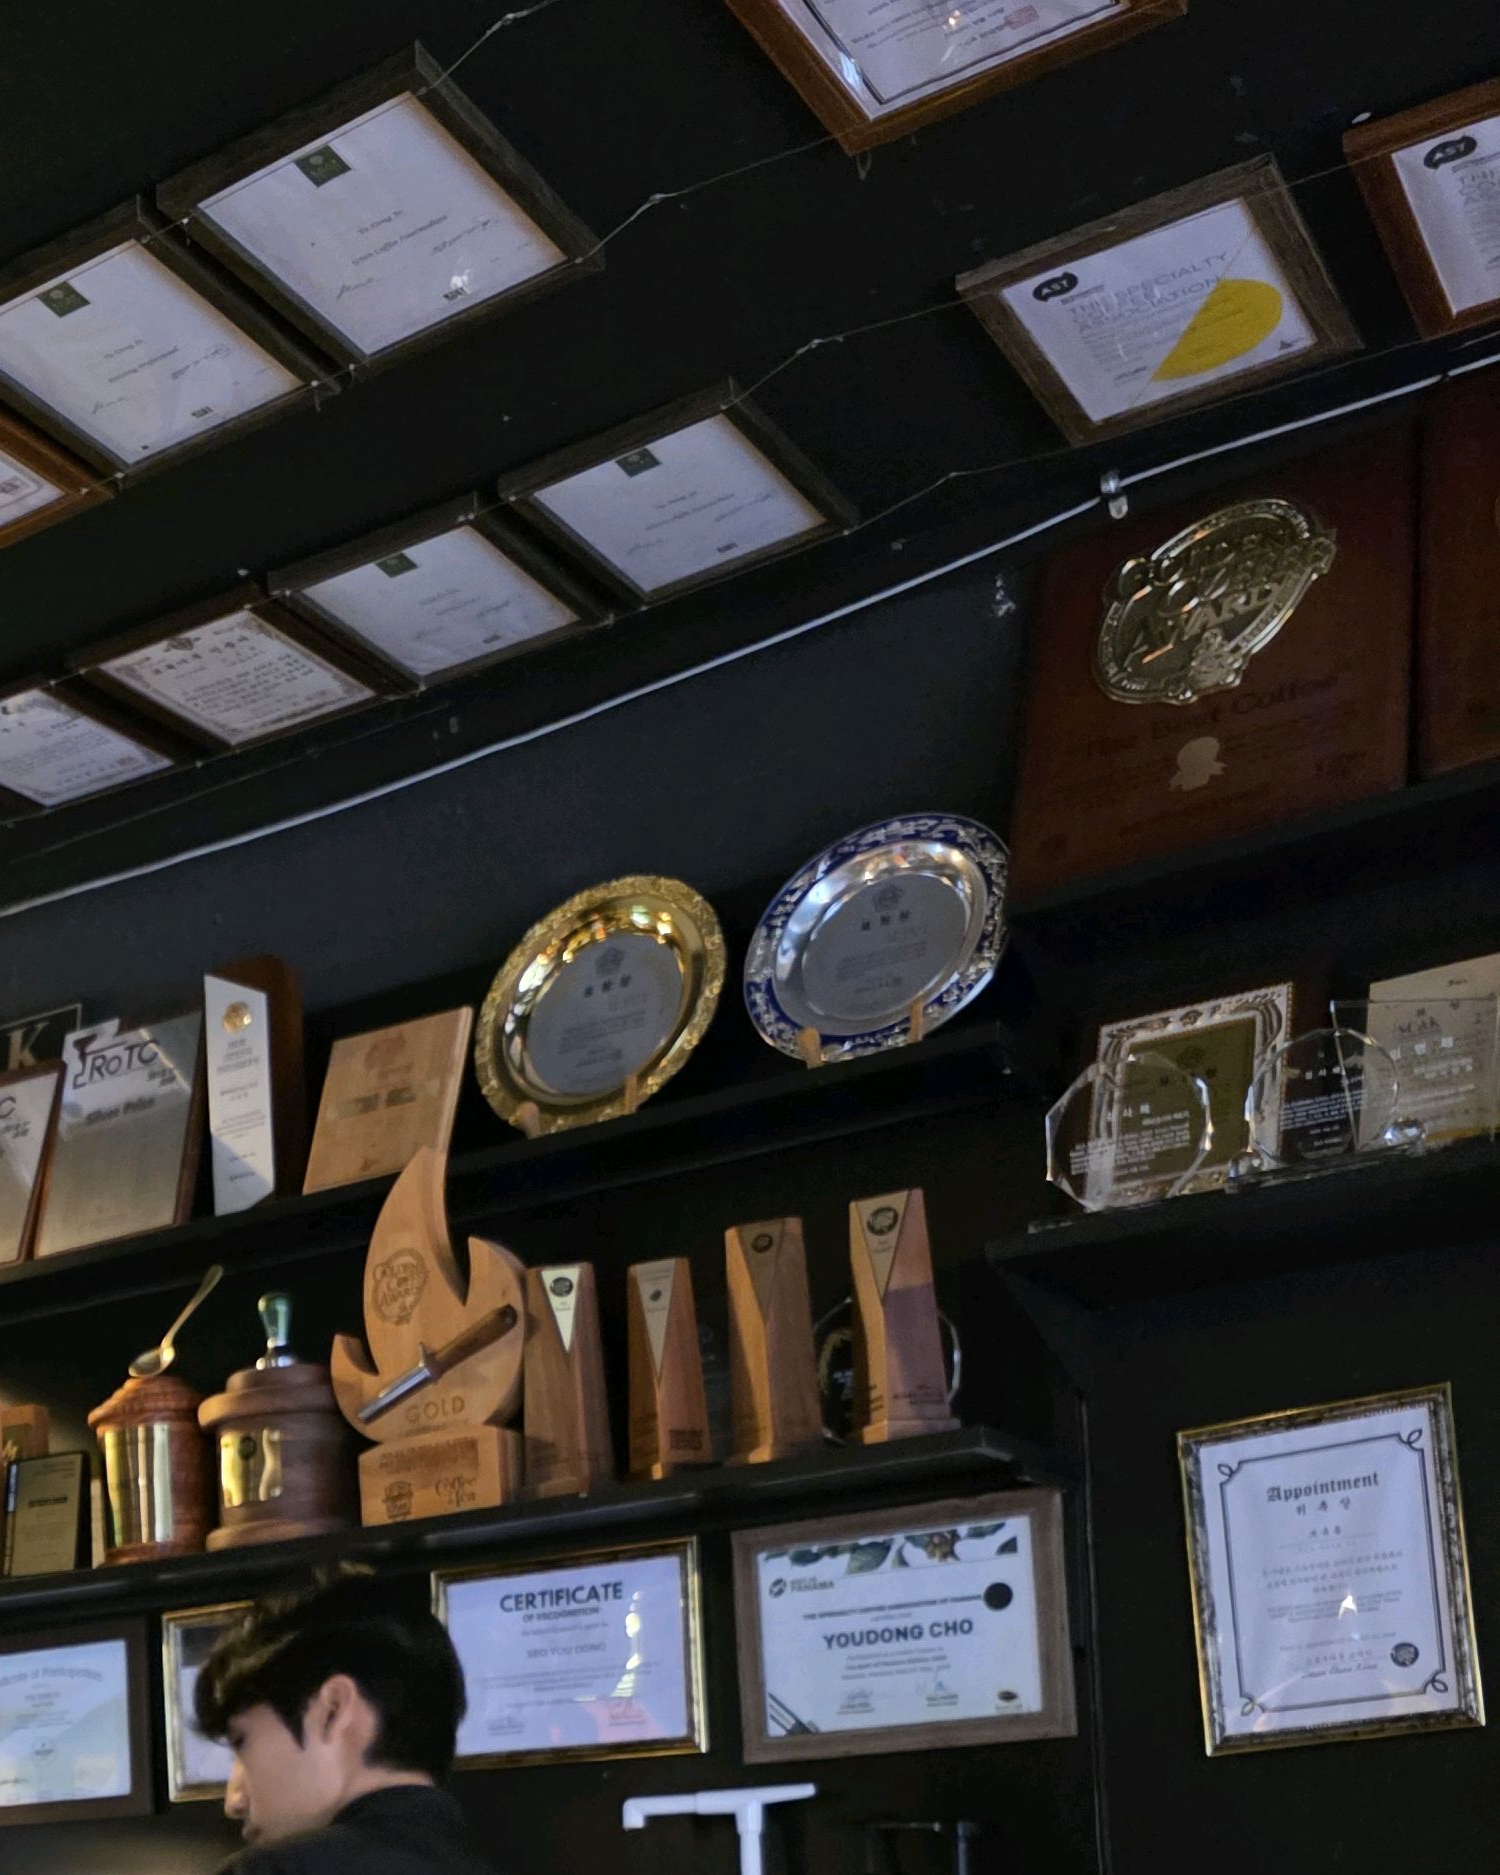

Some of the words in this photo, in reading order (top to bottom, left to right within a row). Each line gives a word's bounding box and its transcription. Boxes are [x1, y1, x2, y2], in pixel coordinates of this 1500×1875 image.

[405, 1396, 466, 1424] GOLD
[1266, 1472, 1380, 1503] Appointment
[500, 1582, 623, 1614] CERTIFICATE
[822, 1624, 924, 1650] YOUDONG
[929, 1618, 974, 1638] CHO
